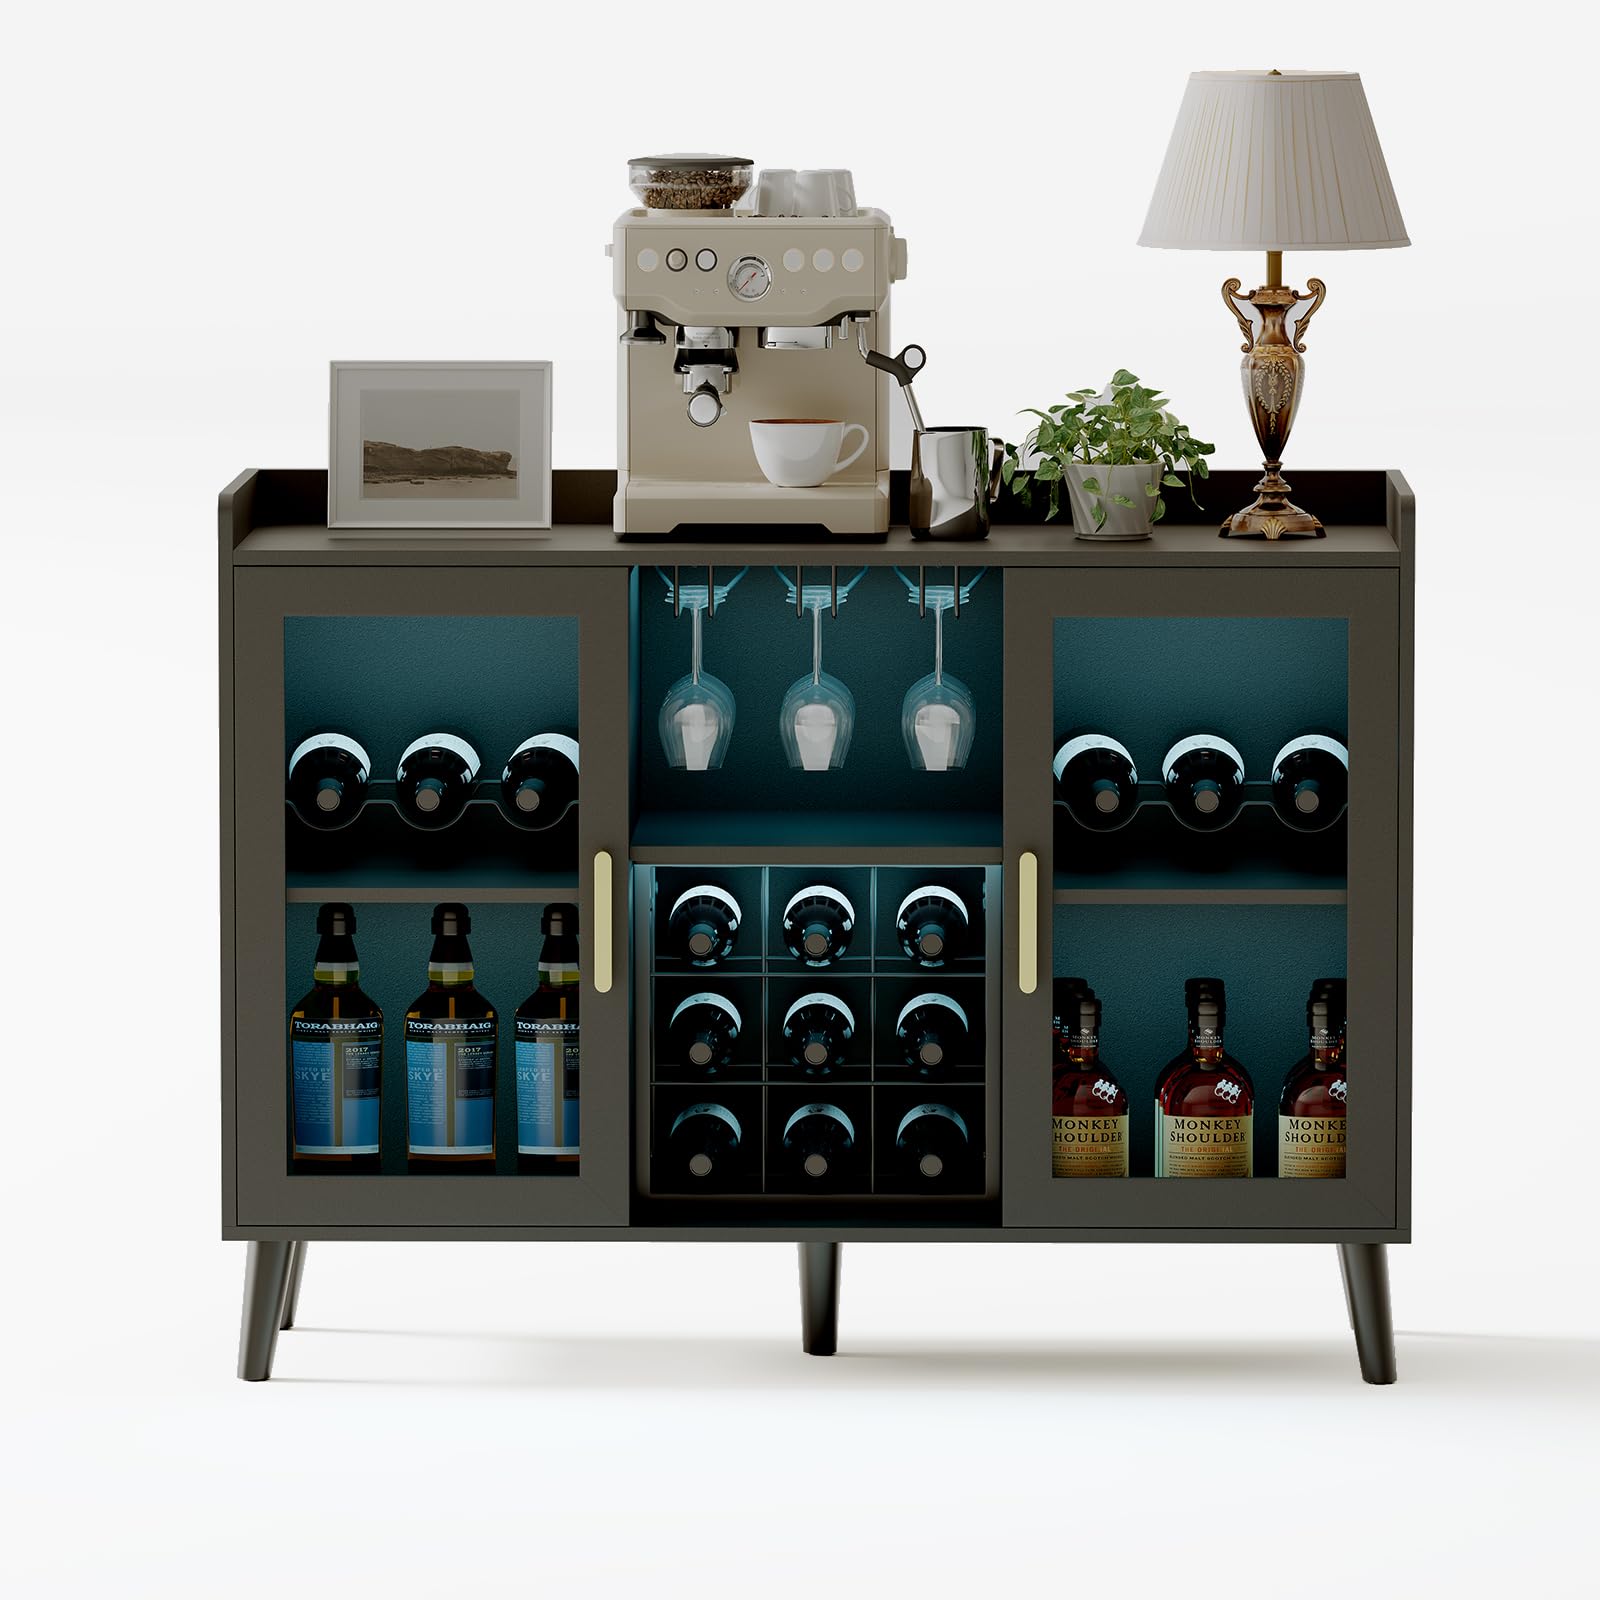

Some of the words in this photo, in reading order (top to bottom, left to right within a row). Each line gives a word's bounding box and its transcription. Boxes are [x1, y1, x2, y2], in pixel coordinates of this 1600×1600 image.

[294, 1020, 378, 1030] TORABHAIG
[407, 1020, 492, 1030] TORABHAIG
[295, 1071, 331, 1081] SKYE
[408, 1071, 444, 1081] SKYE
[517, 1071, 551, 1081] SKYE
[1052, 1118, 1118, 1130] MONKEY
[1174, 1118, 1241, 1130] MONKEY
[1289, 1118, 1346, 1130] MONKE
[1170, 1131, 1246, 1143] SHOULDER
[1284, 1131, 1346, 1143] SHOULD
